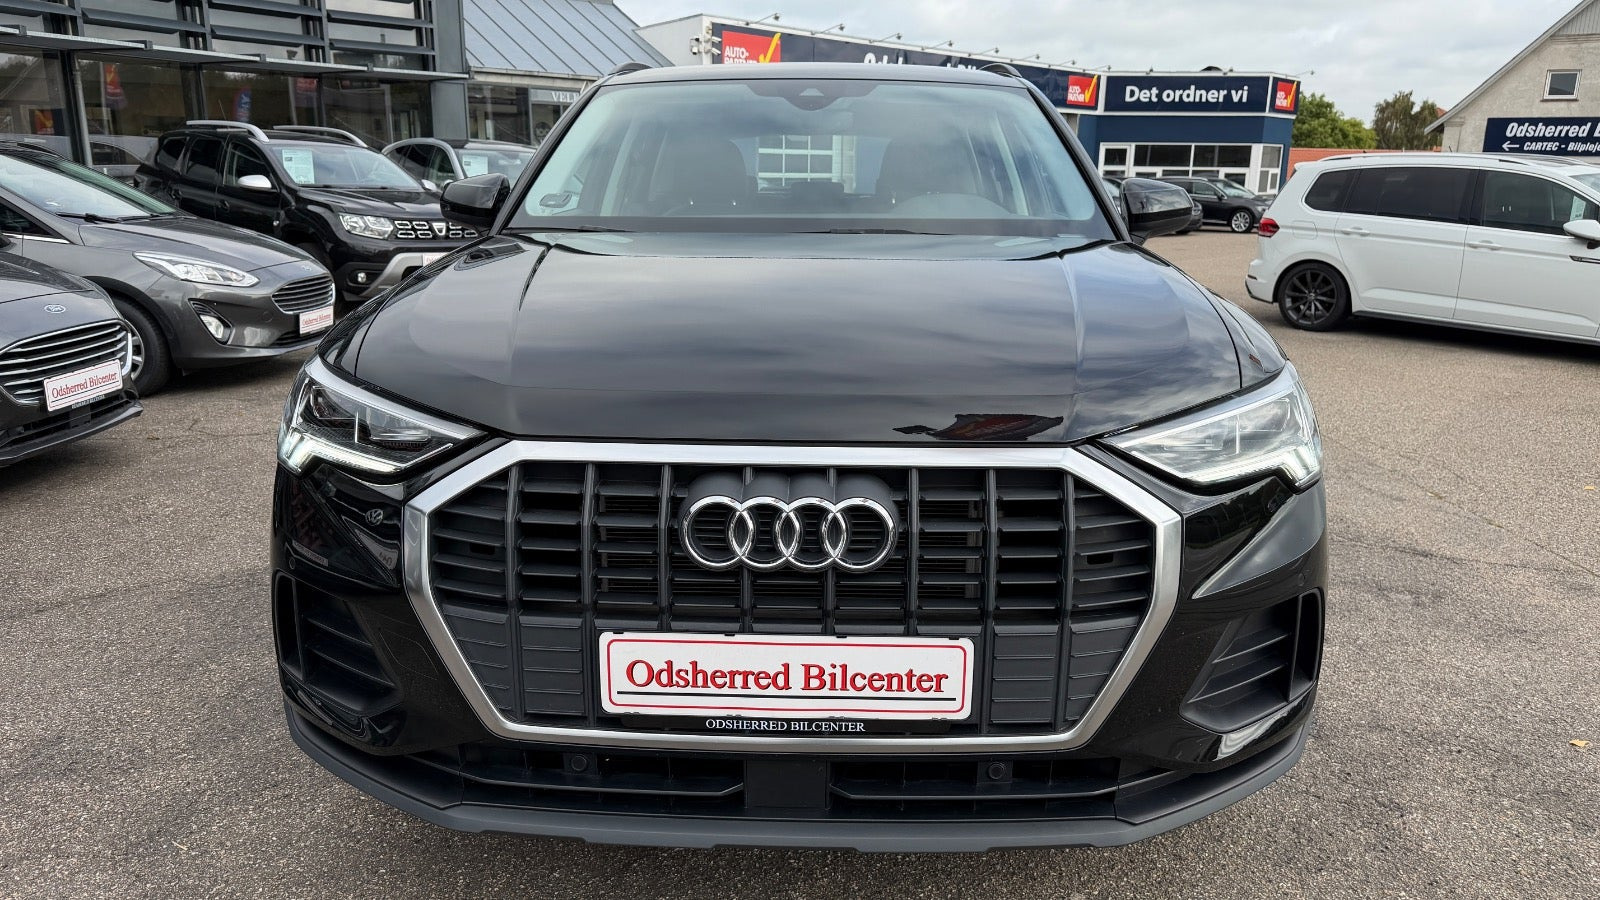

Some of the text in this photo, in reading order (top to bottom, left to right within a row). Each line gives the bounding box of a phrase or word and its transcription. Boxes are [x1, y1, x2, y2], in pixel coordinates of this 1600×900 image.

[724, 45, 750, 59] AUTO-
[1124, 85, 1249, 103] Det ordner vi
[1505, 122, 1592, 138] Odsherred
[1523, 141, 1560, 151] CARTEC
[51, 379, 88, 399] Odsherred
[625, 659, 949, 693] Odsherred Bilcenter
[705, 718, 866, 732] ODSHERRED BILCENTER
